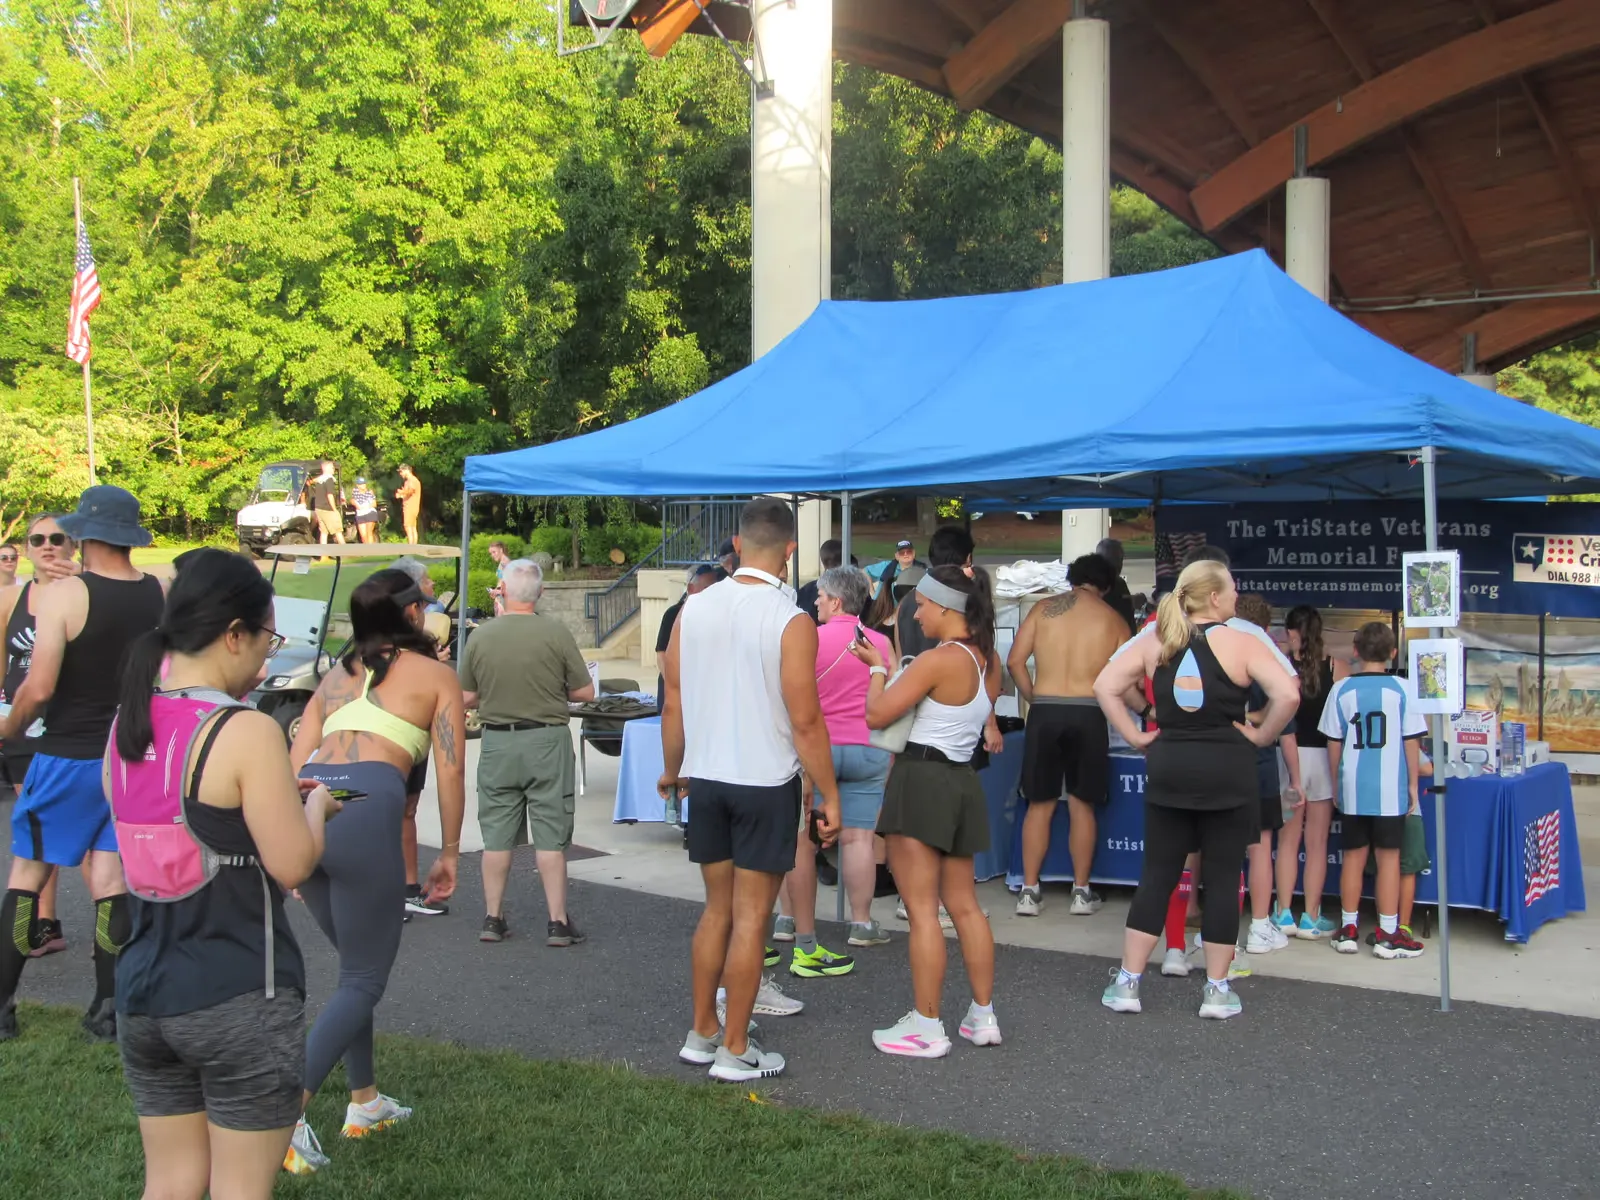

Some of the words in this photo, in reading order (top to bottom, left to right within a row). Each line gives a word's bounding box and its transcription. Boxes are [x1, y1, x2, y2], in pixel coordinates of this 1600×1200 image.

[1227, 519, 1266, 538] The
[1274, 518, 1372, 537] TriState
[1380, 517, 1491, 537] Vetrans
[1266, 545, 1377, 565] Memorial
[1547, 571, 1570, 582] DIAL
[1571, 572, 1591, 583] 988
[1349, 711, 1387, 750] 10
